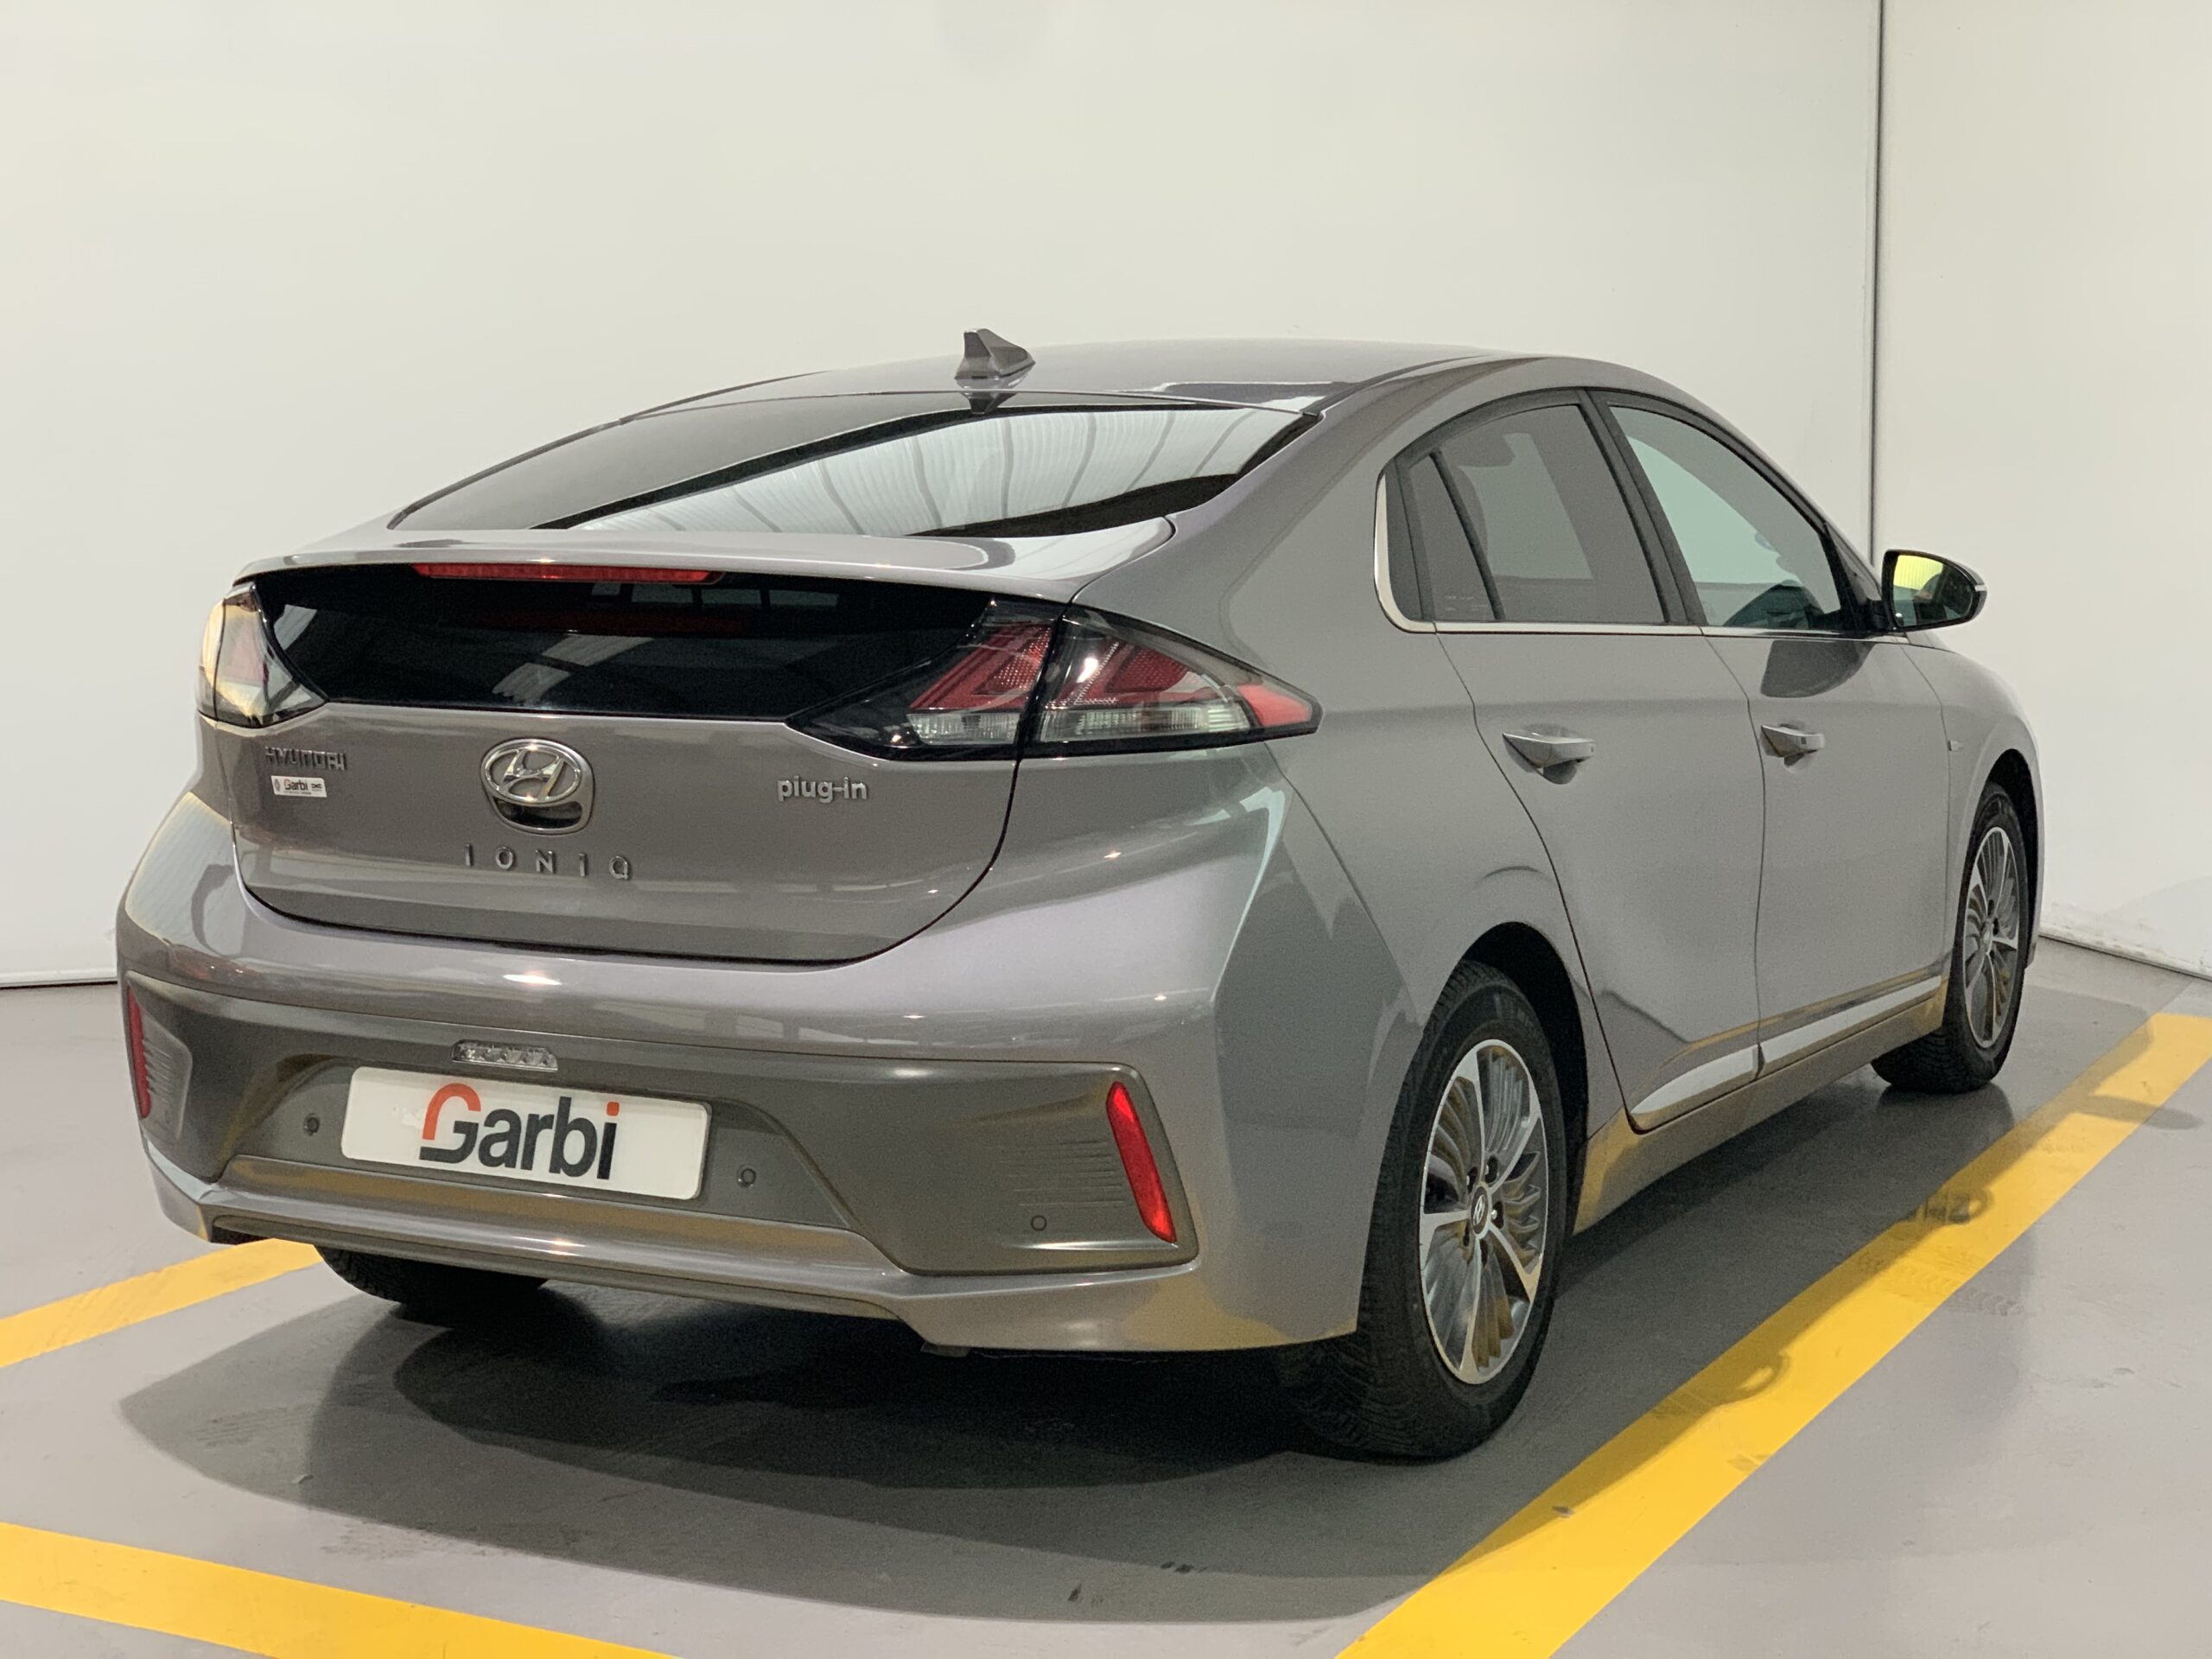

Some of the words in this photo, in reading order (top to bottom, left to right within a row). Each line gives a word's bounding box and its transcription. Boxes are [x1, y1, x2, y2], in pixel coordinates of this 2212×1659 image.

[264, 747, 346, 771] HYUNDAI
[283, 779, 308, 791] Garbi
[778, 775, 868, 804] plug-in
[464, 843, 632, 880] IONIQ
[419, 1083, 620, 1179] Garbi
